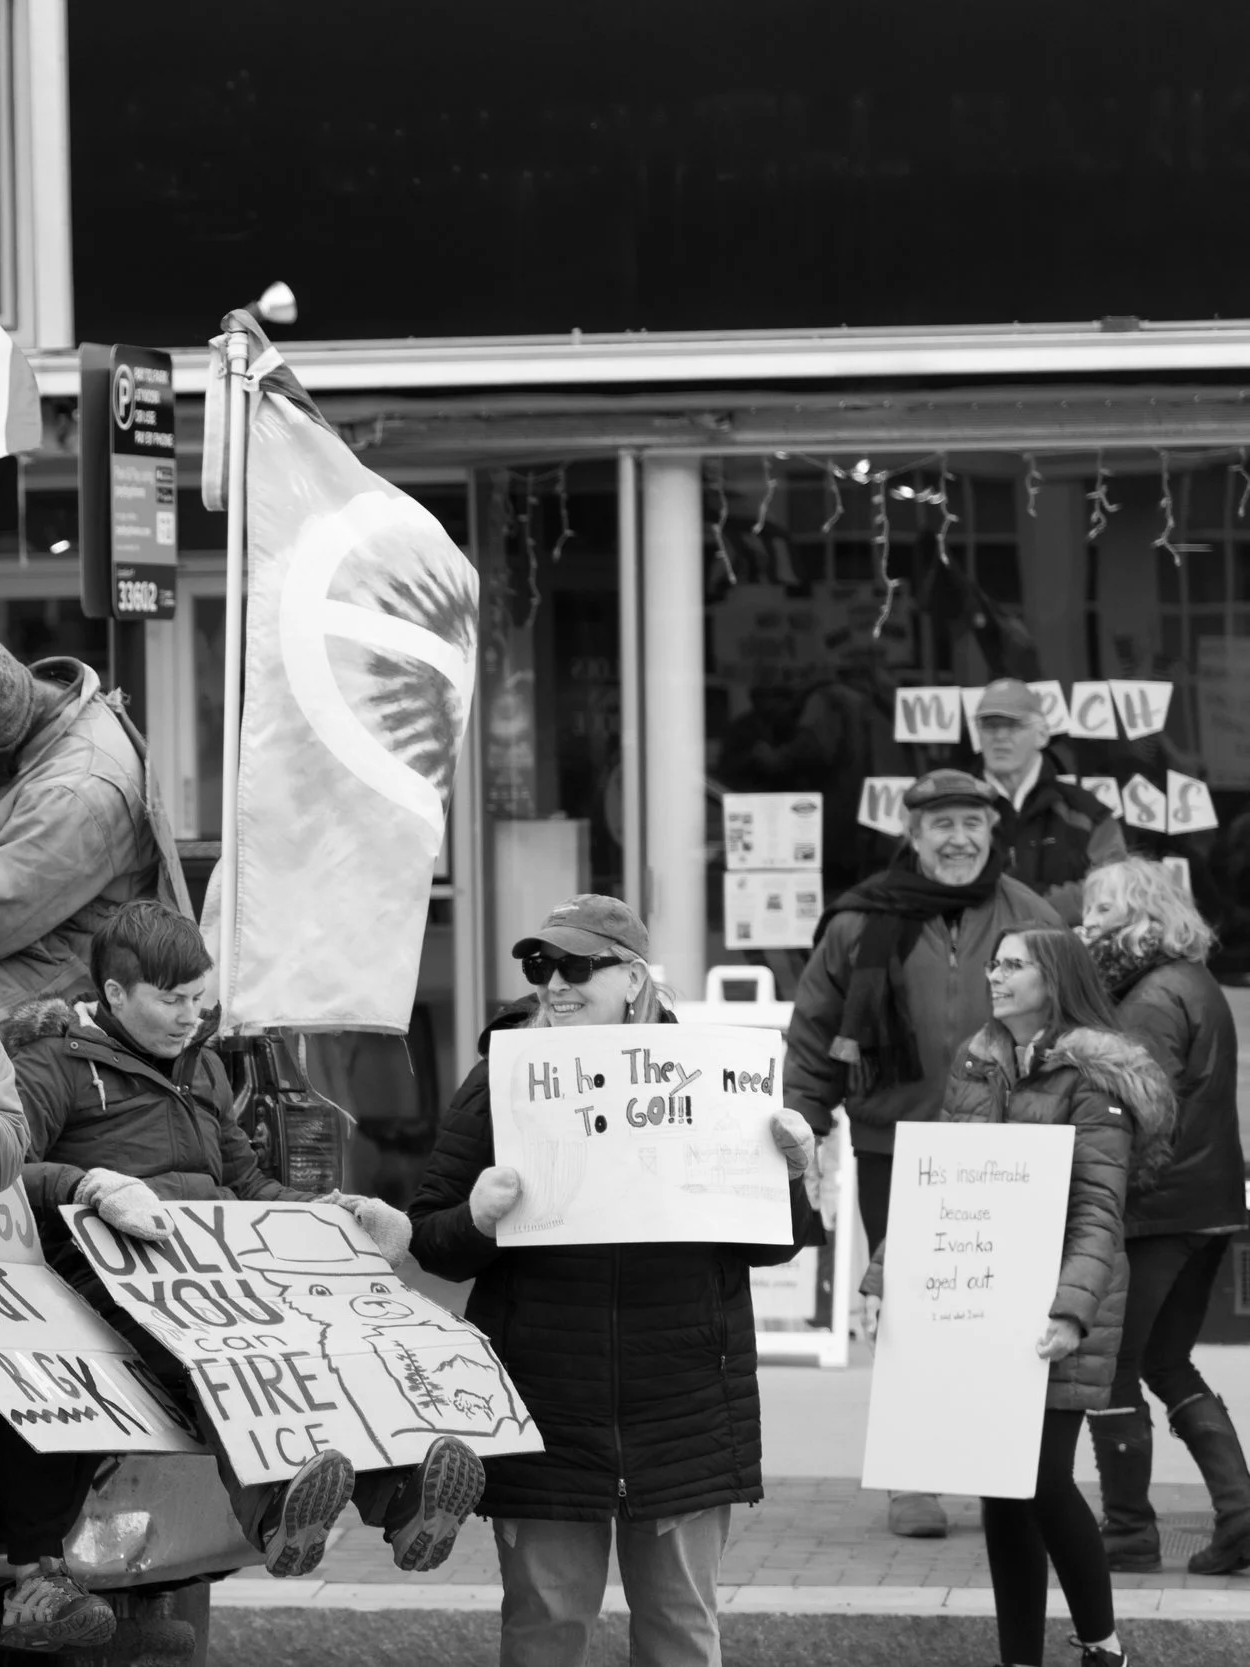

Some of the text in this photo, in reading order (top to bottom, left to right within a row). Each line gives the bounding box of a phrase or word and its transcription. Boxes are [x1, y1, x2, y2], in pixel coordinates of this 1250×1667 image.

[574, 1057, 606, 1094] ho
[621, 1048, 702, 1097] They
[722, 1057, 776, 1096] need
[626, 1095, 693, 1128] GO!!!
[956, 1159, 1031, 1185] insufferable
[939, 1197, 992, 1221] because
[73, 1205, 244, 1276] ONLY
[933, 1230, 994, 1253] Ivanka
[925, 1265, 958, 1302] aged
[118, 1278, 286, 1330] YOU
[194, 1330, 288, 1353] can
[191, 1351, 338, 1421] FIRE
